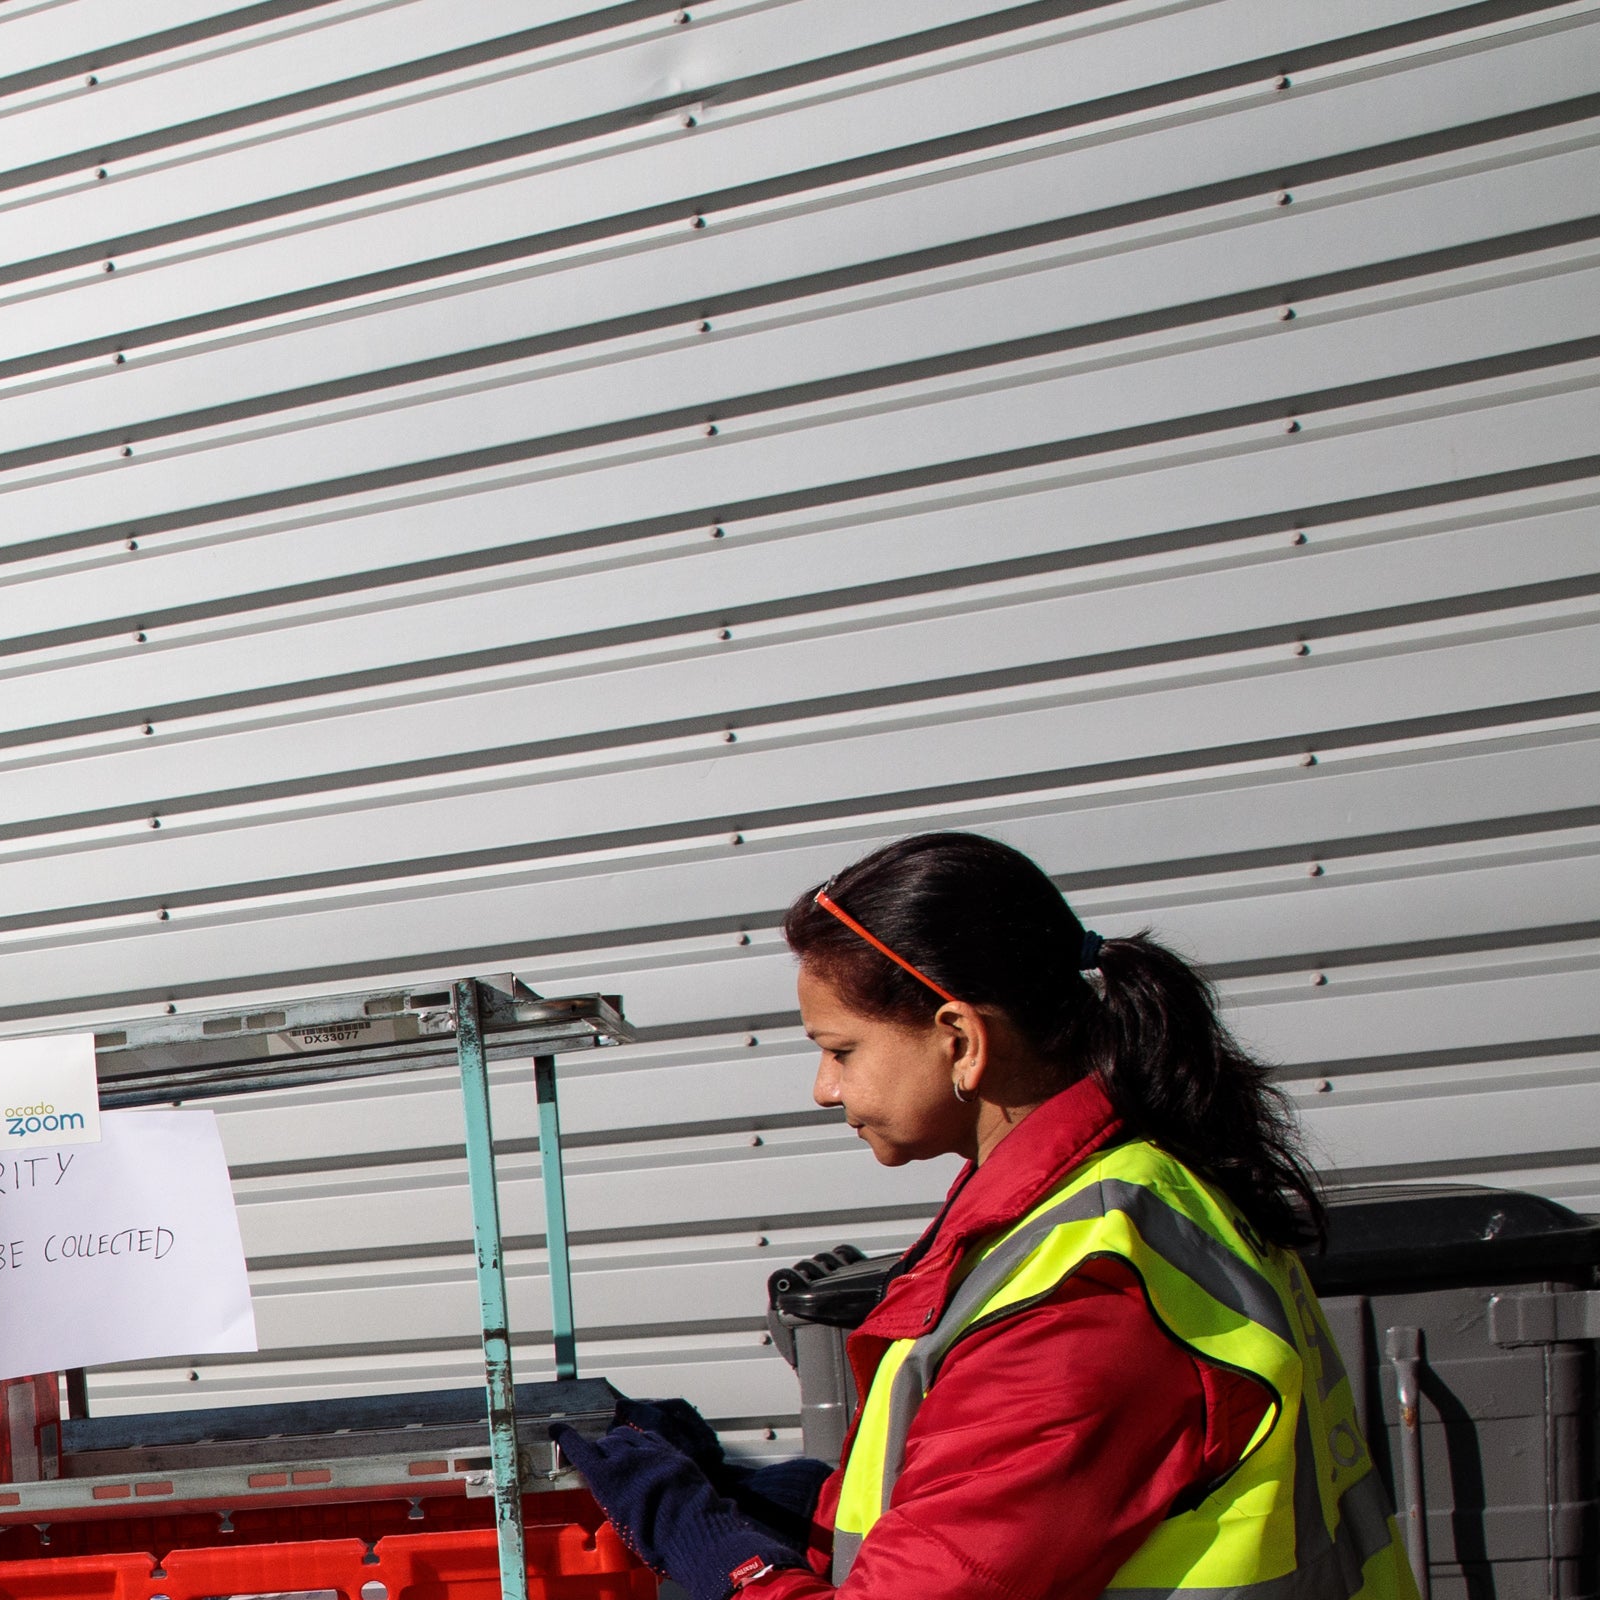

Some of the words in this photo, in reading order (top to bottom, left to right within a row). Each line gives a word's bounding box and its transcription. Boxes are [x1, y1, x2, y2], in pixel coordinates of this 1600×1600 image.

[304, 1031, 359, 1045] DX33077
[4, 1101, 55, 1118] ocado
[5, 1112, 85, 1137] zoom
[44, 1226, 175, 1263] COLLECTED
